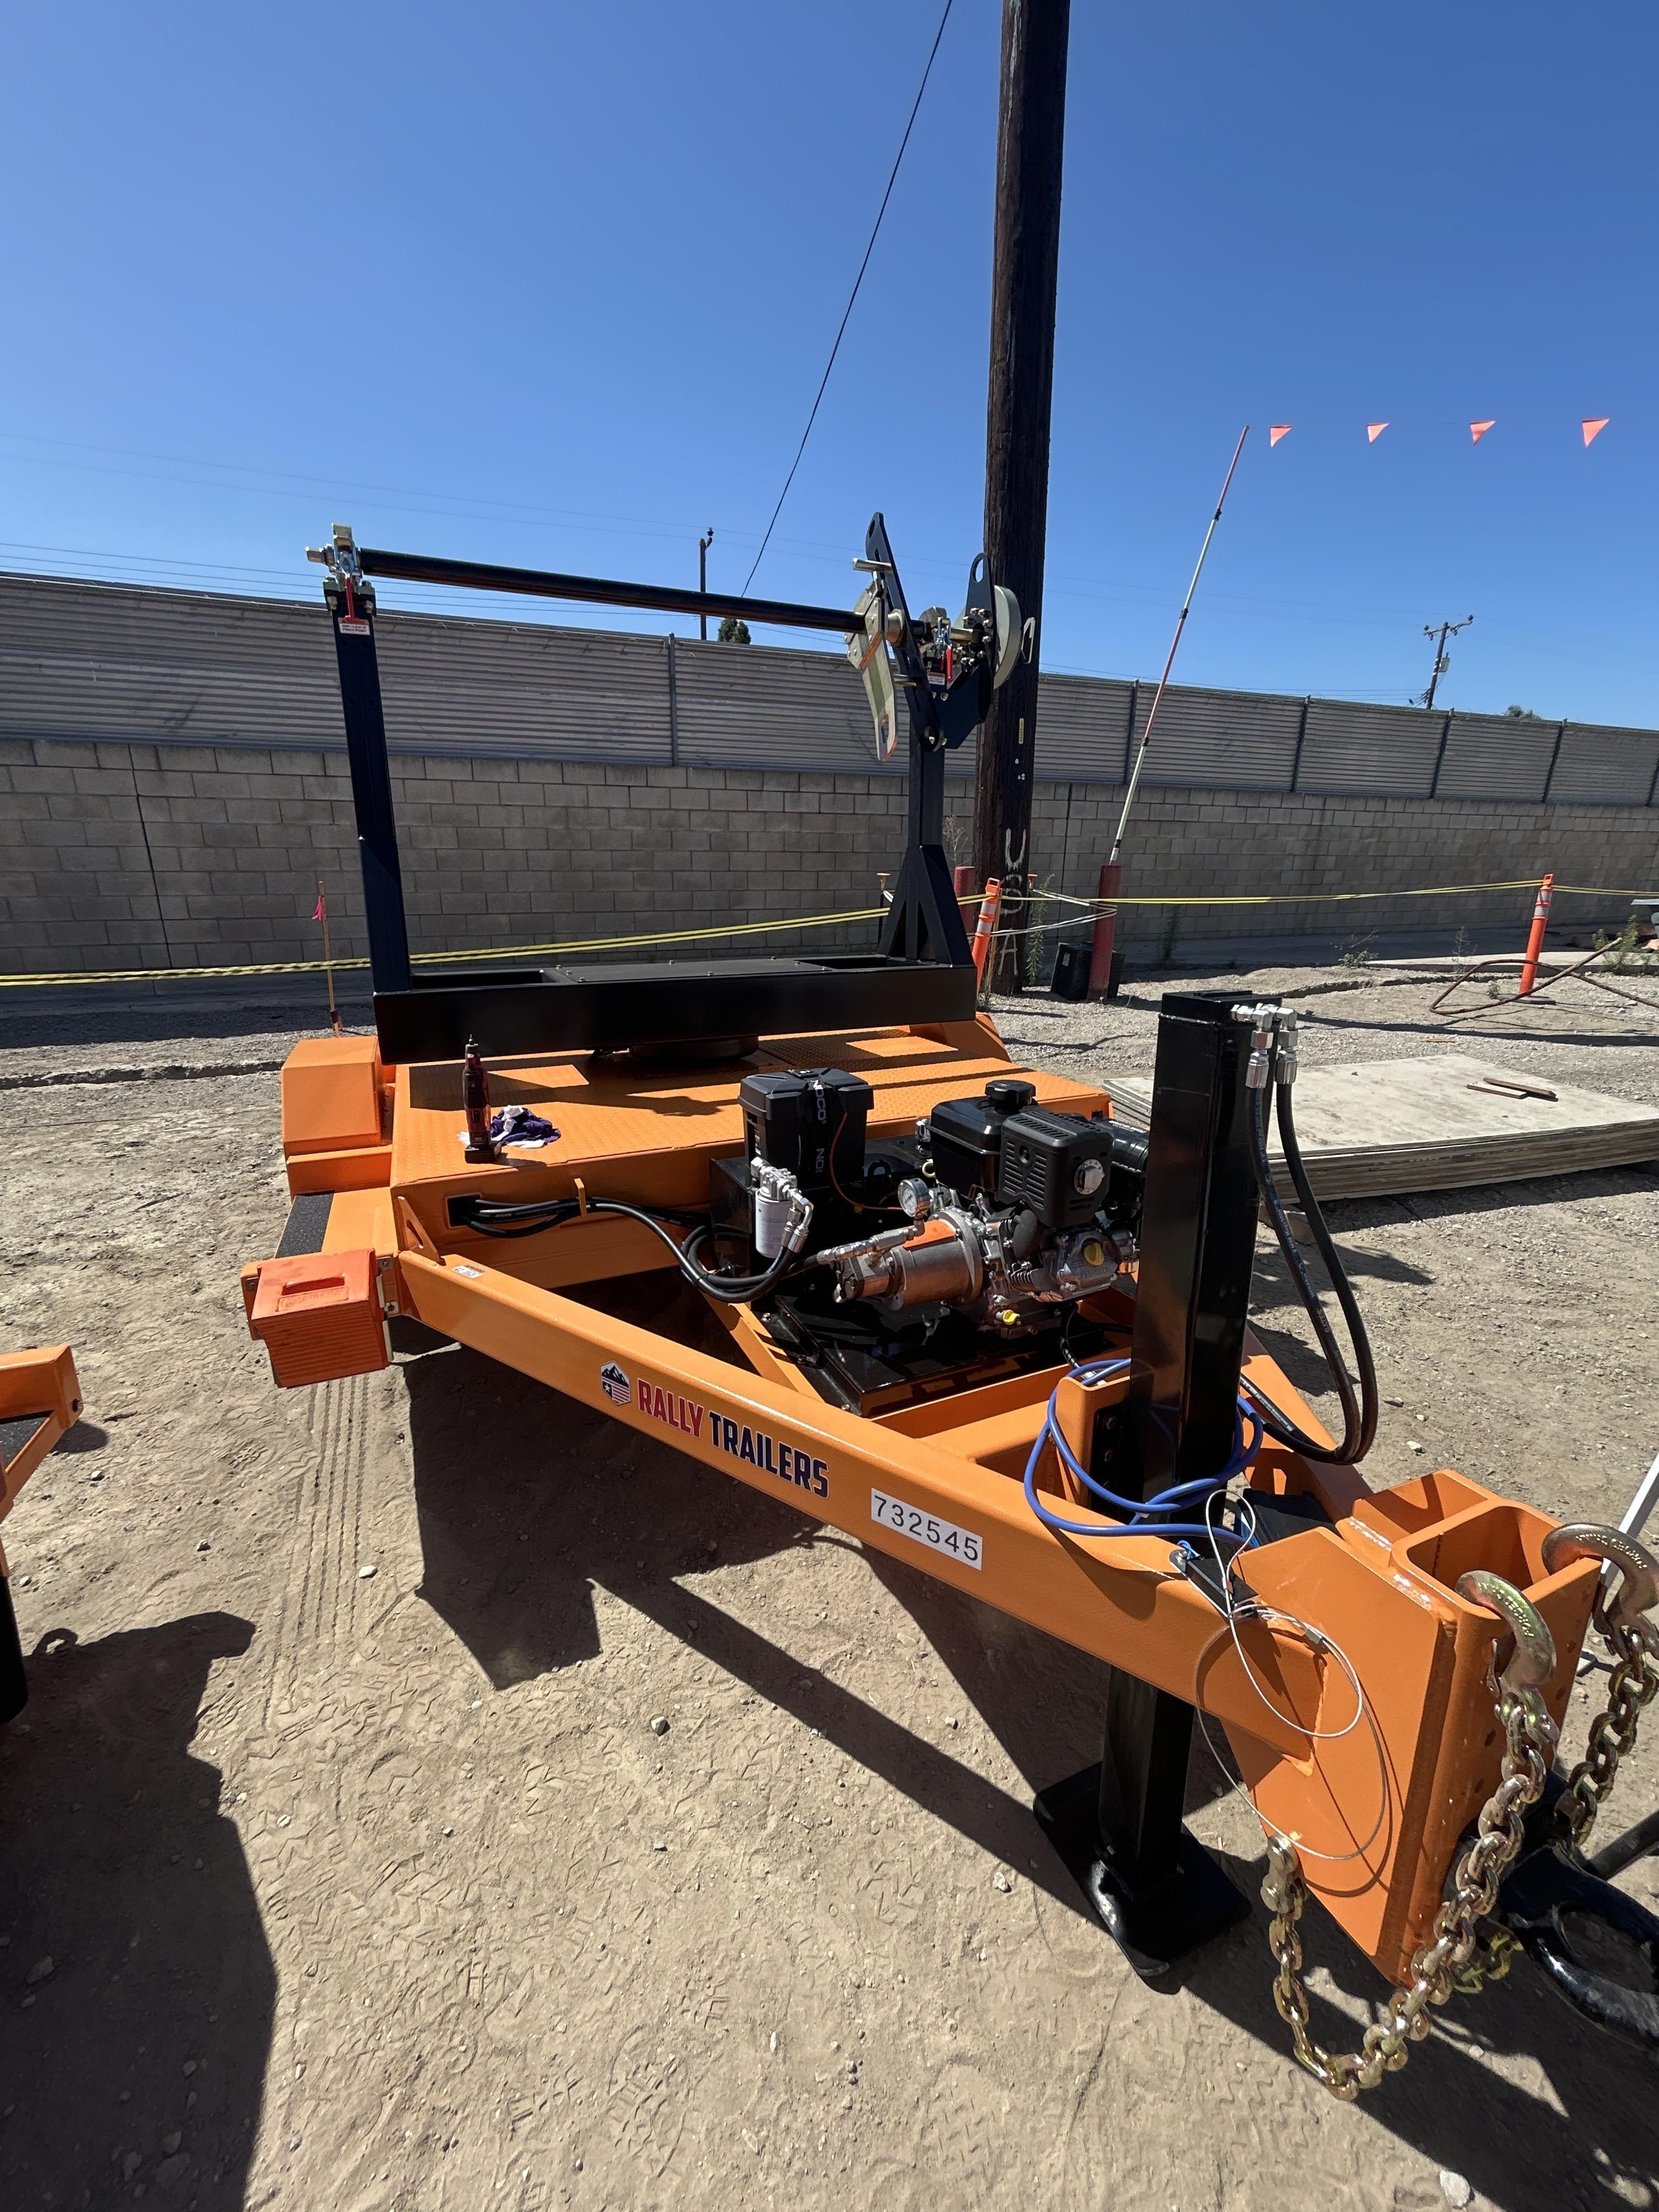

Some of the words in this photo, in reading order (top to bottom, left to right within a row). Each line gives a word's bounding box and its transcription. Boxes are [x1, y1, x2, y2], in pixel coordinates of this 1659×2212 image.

[810, 1080, 826, 1122] NOCO
[637, 1378, 704, 1439] RALLY
[708, 1410, 830, 1499] TRAILERS
[874, 1494, 979, 1562] 732545
